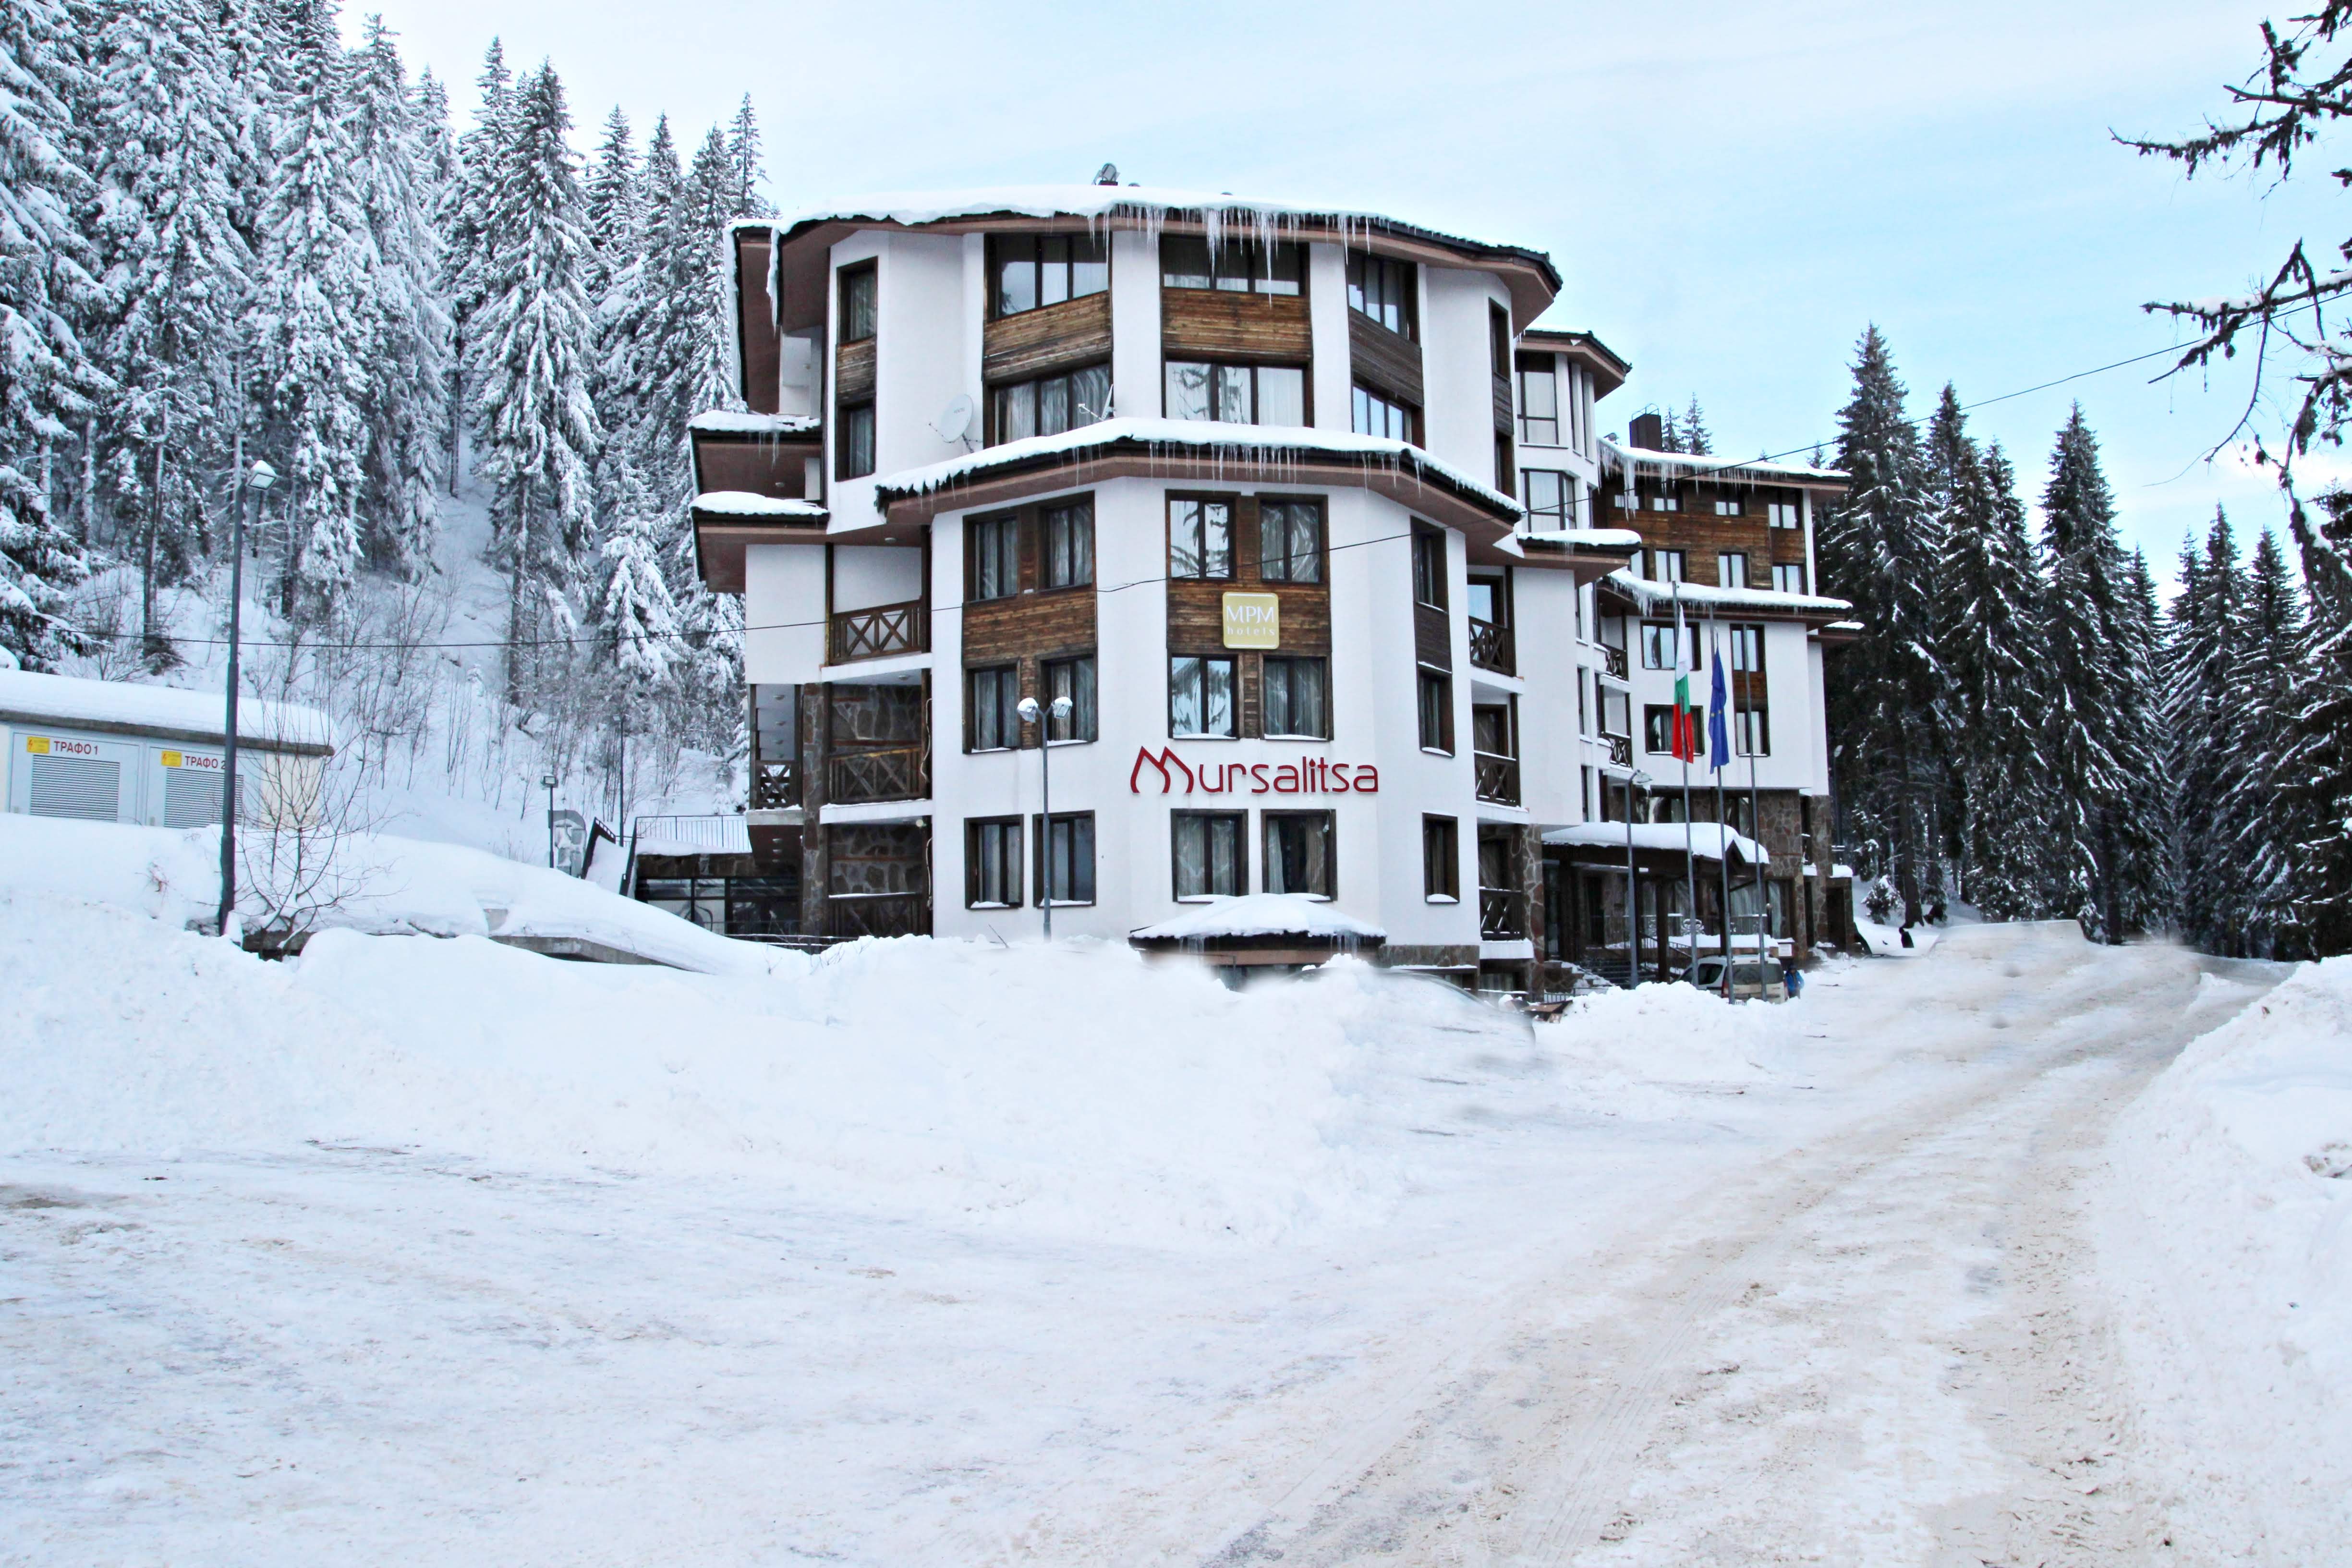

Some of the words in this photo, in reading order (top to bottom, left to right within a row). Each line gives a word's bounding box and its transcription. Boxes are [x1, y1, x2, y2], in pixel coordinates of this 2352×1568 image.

[1226, 605, 1274, 623] MPM
[1227, 626, 1275, 635] hotels
[54, 741, 91, 754] ТРАФО
[94, 745, 98, 754] 1
[185, 756, 218, 768] ТРАФО
[221, 760, 226, 769] 2
[1130, 746, 1379, 793] Mursalitsa
